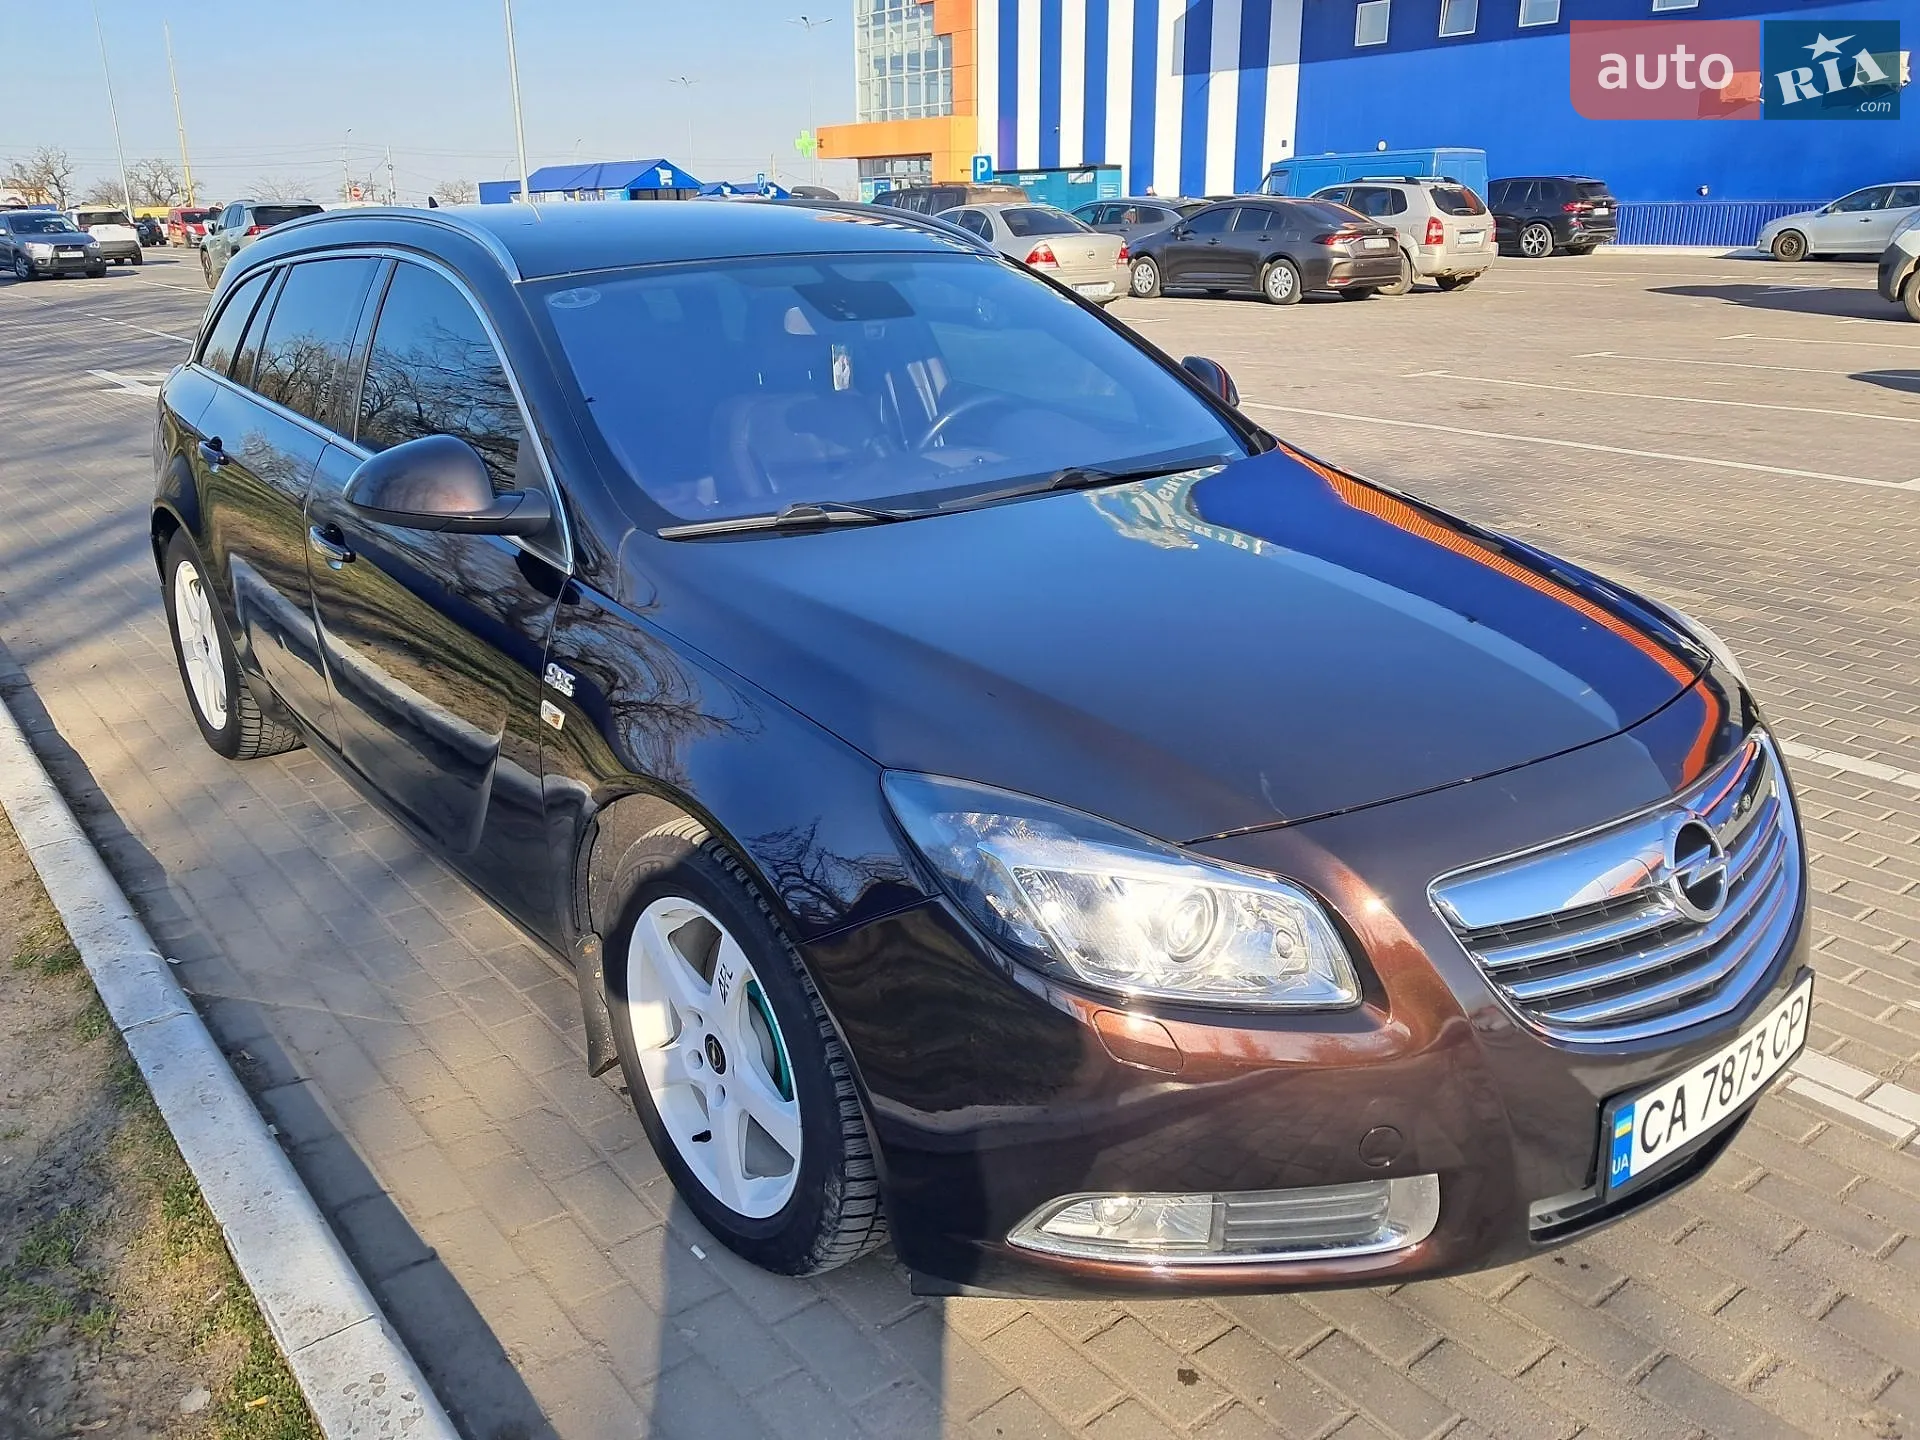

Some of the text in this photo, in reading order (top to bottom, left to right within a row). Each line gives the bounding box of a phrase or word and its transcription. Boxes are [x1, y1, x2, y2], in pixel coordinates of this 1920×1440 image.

[976, 158, 988, 180] P
[1640, 995, 1804, 1154] CA 7873 CP
[1612, 1156, 1630, 1175] UA
